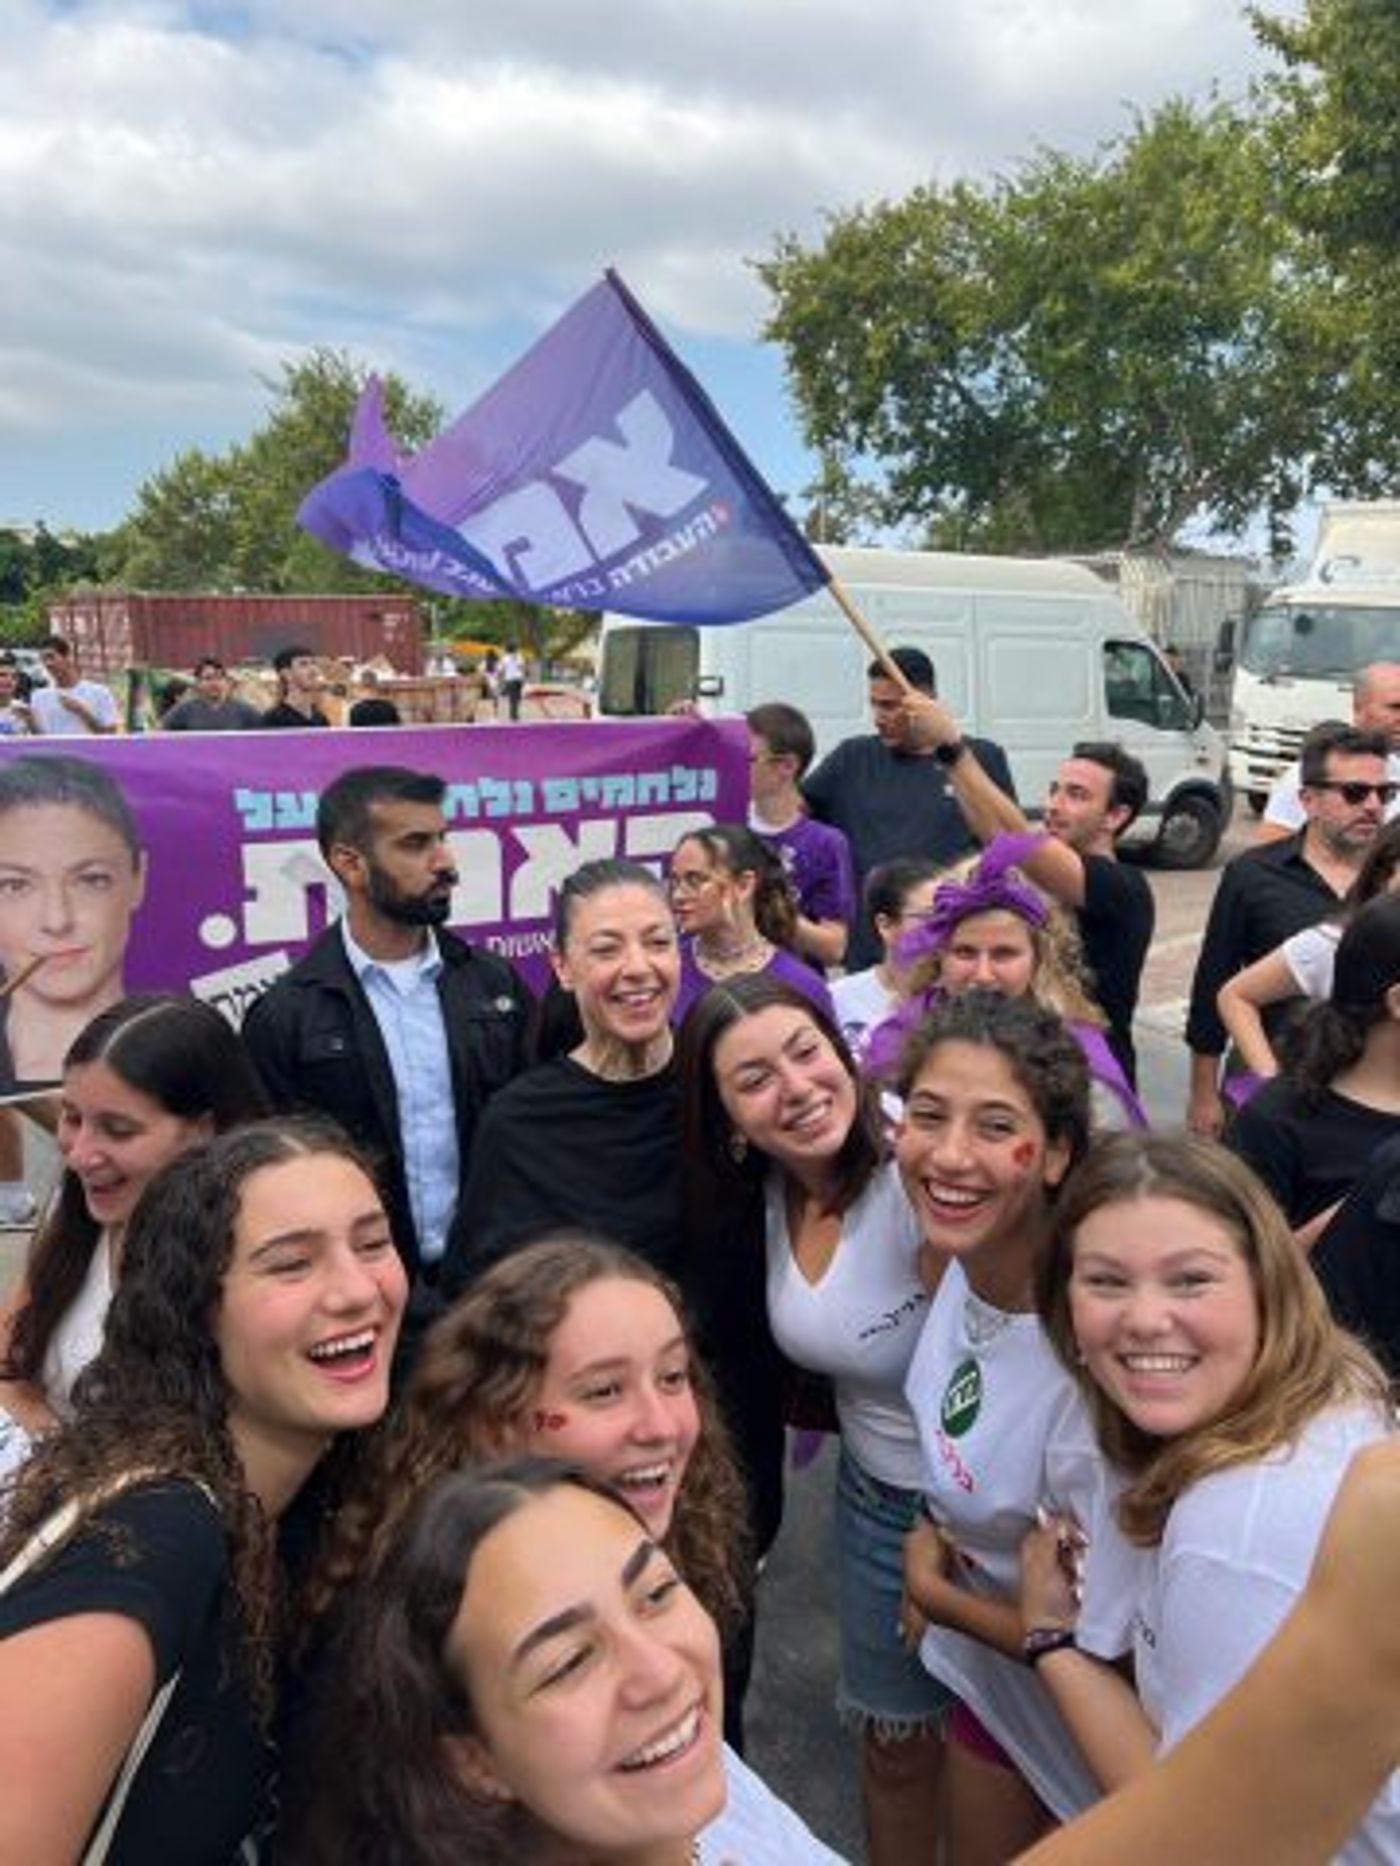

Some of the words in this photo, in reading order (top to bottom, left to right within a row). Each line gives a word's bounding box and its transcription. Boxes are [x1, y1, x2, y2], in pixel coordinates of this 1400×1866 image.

[455, 388, 708, 592] אמ
[233, 788, 320, 832] על
[442, 776, 534, 818] נלח
[541, 766, 717, 812] נלחמים
